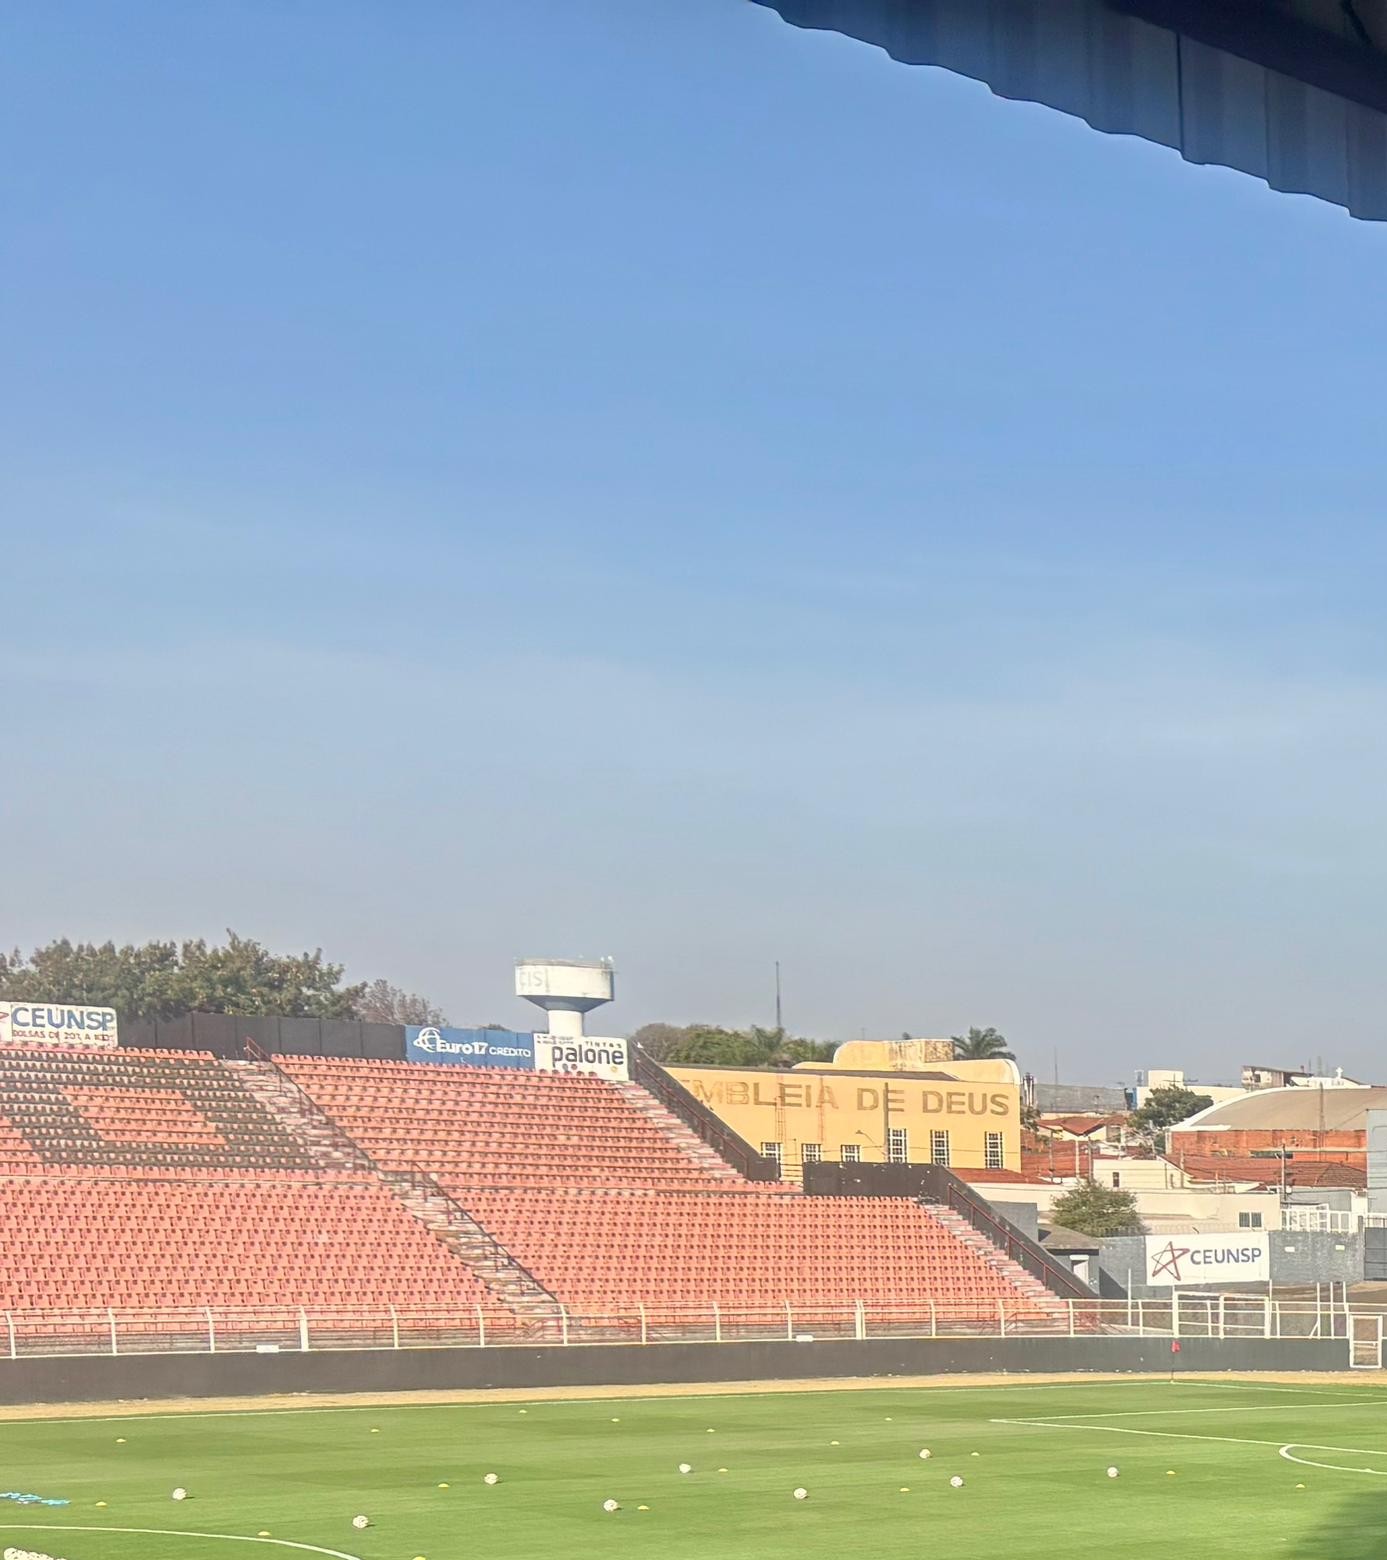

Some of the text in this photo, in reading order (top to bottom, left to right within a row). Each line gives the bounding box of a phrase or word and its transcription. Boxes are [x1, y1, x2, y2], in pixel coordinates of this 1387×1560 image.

[11, 1006, 115, 1031] CEUNSP
[437, 1039, 489, 1055] Euro17
[551, 1044, 624, 1068] palone
[680, 1079, 1010, 1117] MBLEIA DE DEUS
[1190, 1247, 1262, 1265] CEUNSP
